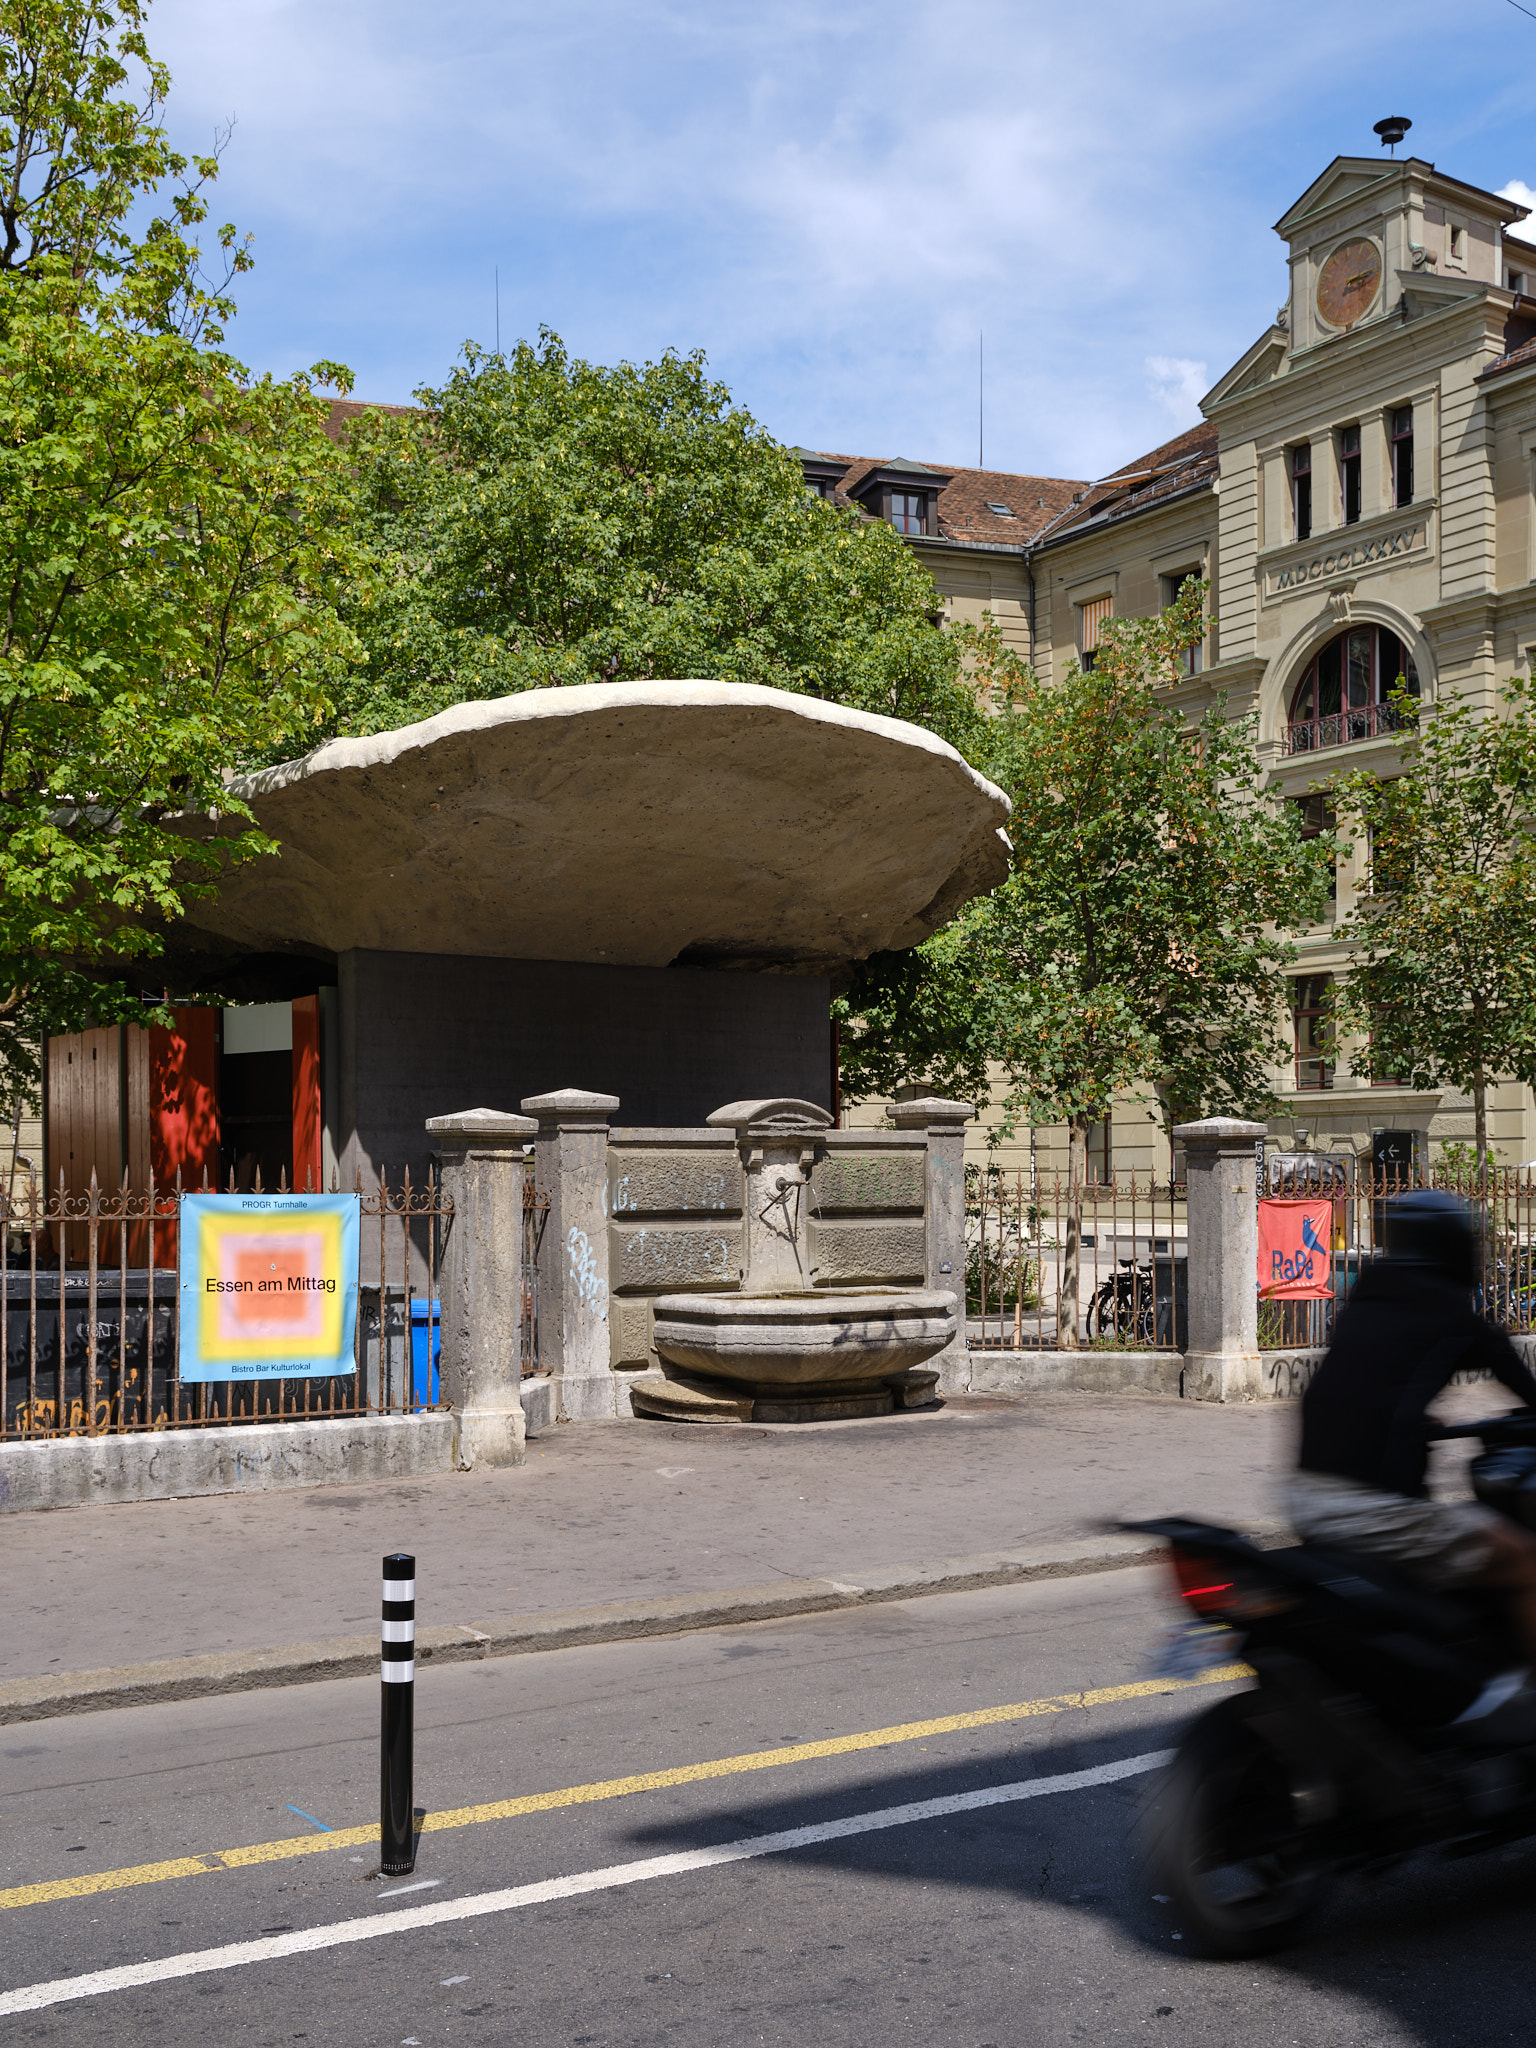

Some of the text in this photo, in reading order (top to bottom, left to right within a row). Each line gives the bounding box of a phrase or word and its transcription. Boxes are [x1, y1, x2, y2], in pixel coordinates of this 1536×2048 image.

[1277, 528, 1417, 591] MDCCCLXXXV
[1255, 1140, 1264, 1163] OST
[242, 1201, 308, 1209] PROGR Turnhalle
[1272, 1250, 1314, 1281] RaBe
[206, 1277, 336, 1293] Essen am Mittag
[231, 1363, 311, 1373] Bistro Bar Kulturlokal
